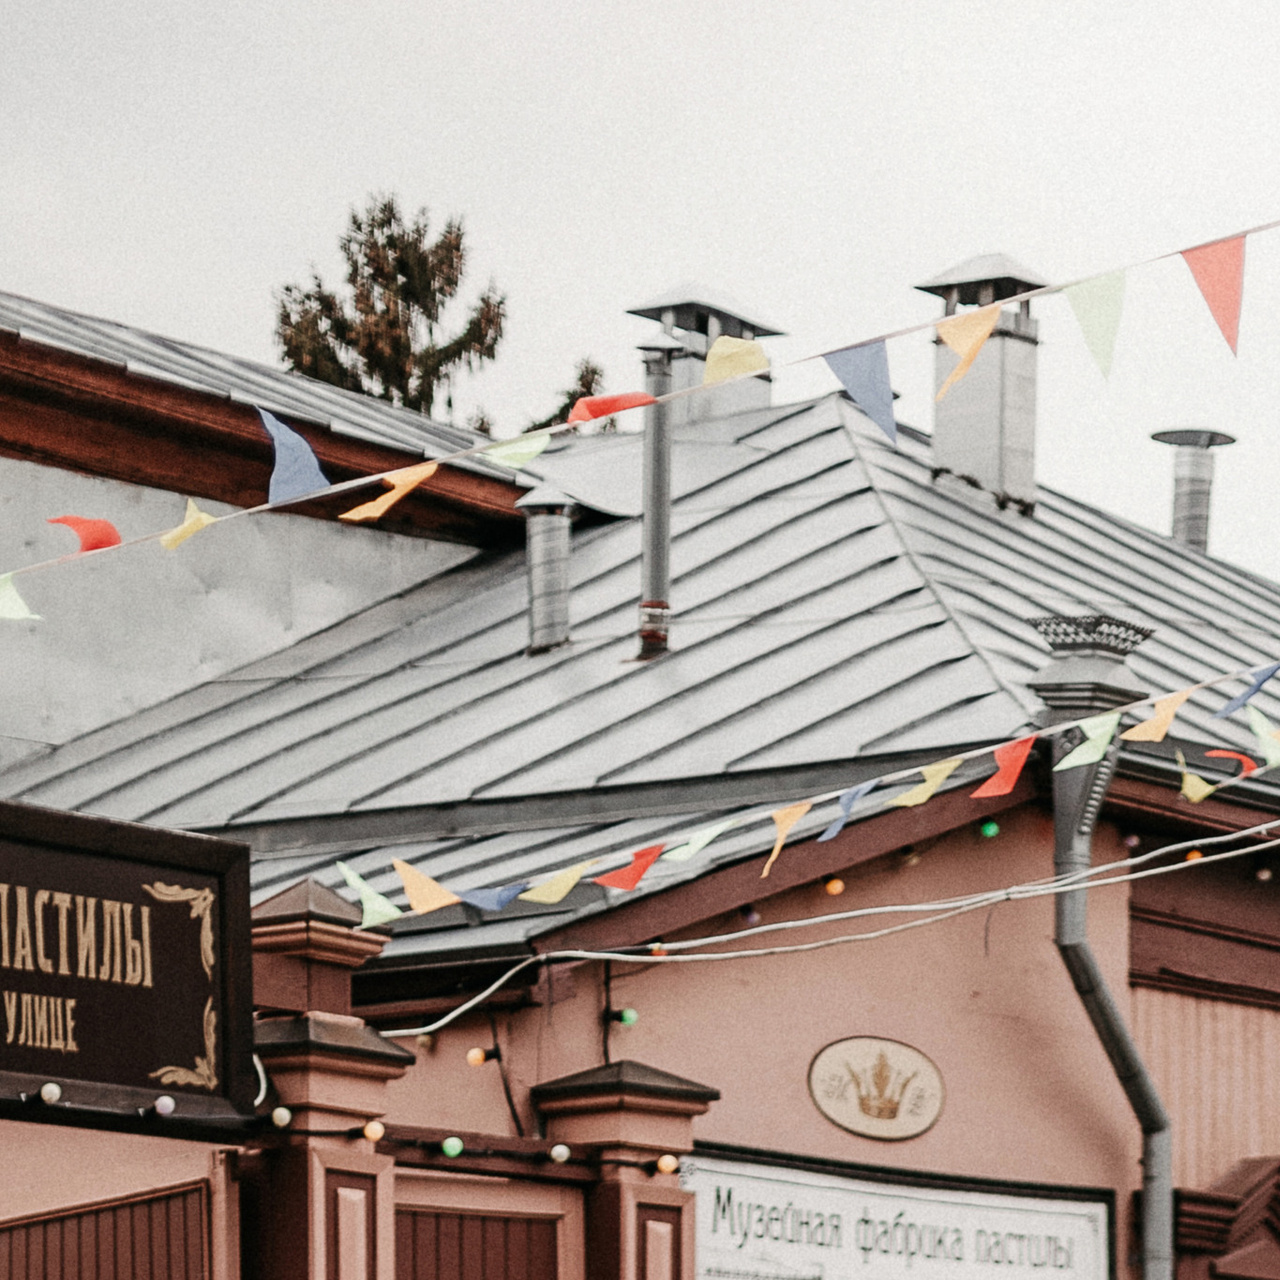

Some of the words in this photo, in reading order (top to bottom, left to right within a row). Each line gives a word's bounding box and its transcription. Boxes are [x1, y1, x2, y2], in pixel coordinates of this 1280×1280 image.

[3, 990, 80, 1054] УЛИЦЕ
[712, 1185, 843, 1250] Музейная
[855, 1206, 965, 1268] фабрика
[974, 1228, 1074, 1269] пастилы
